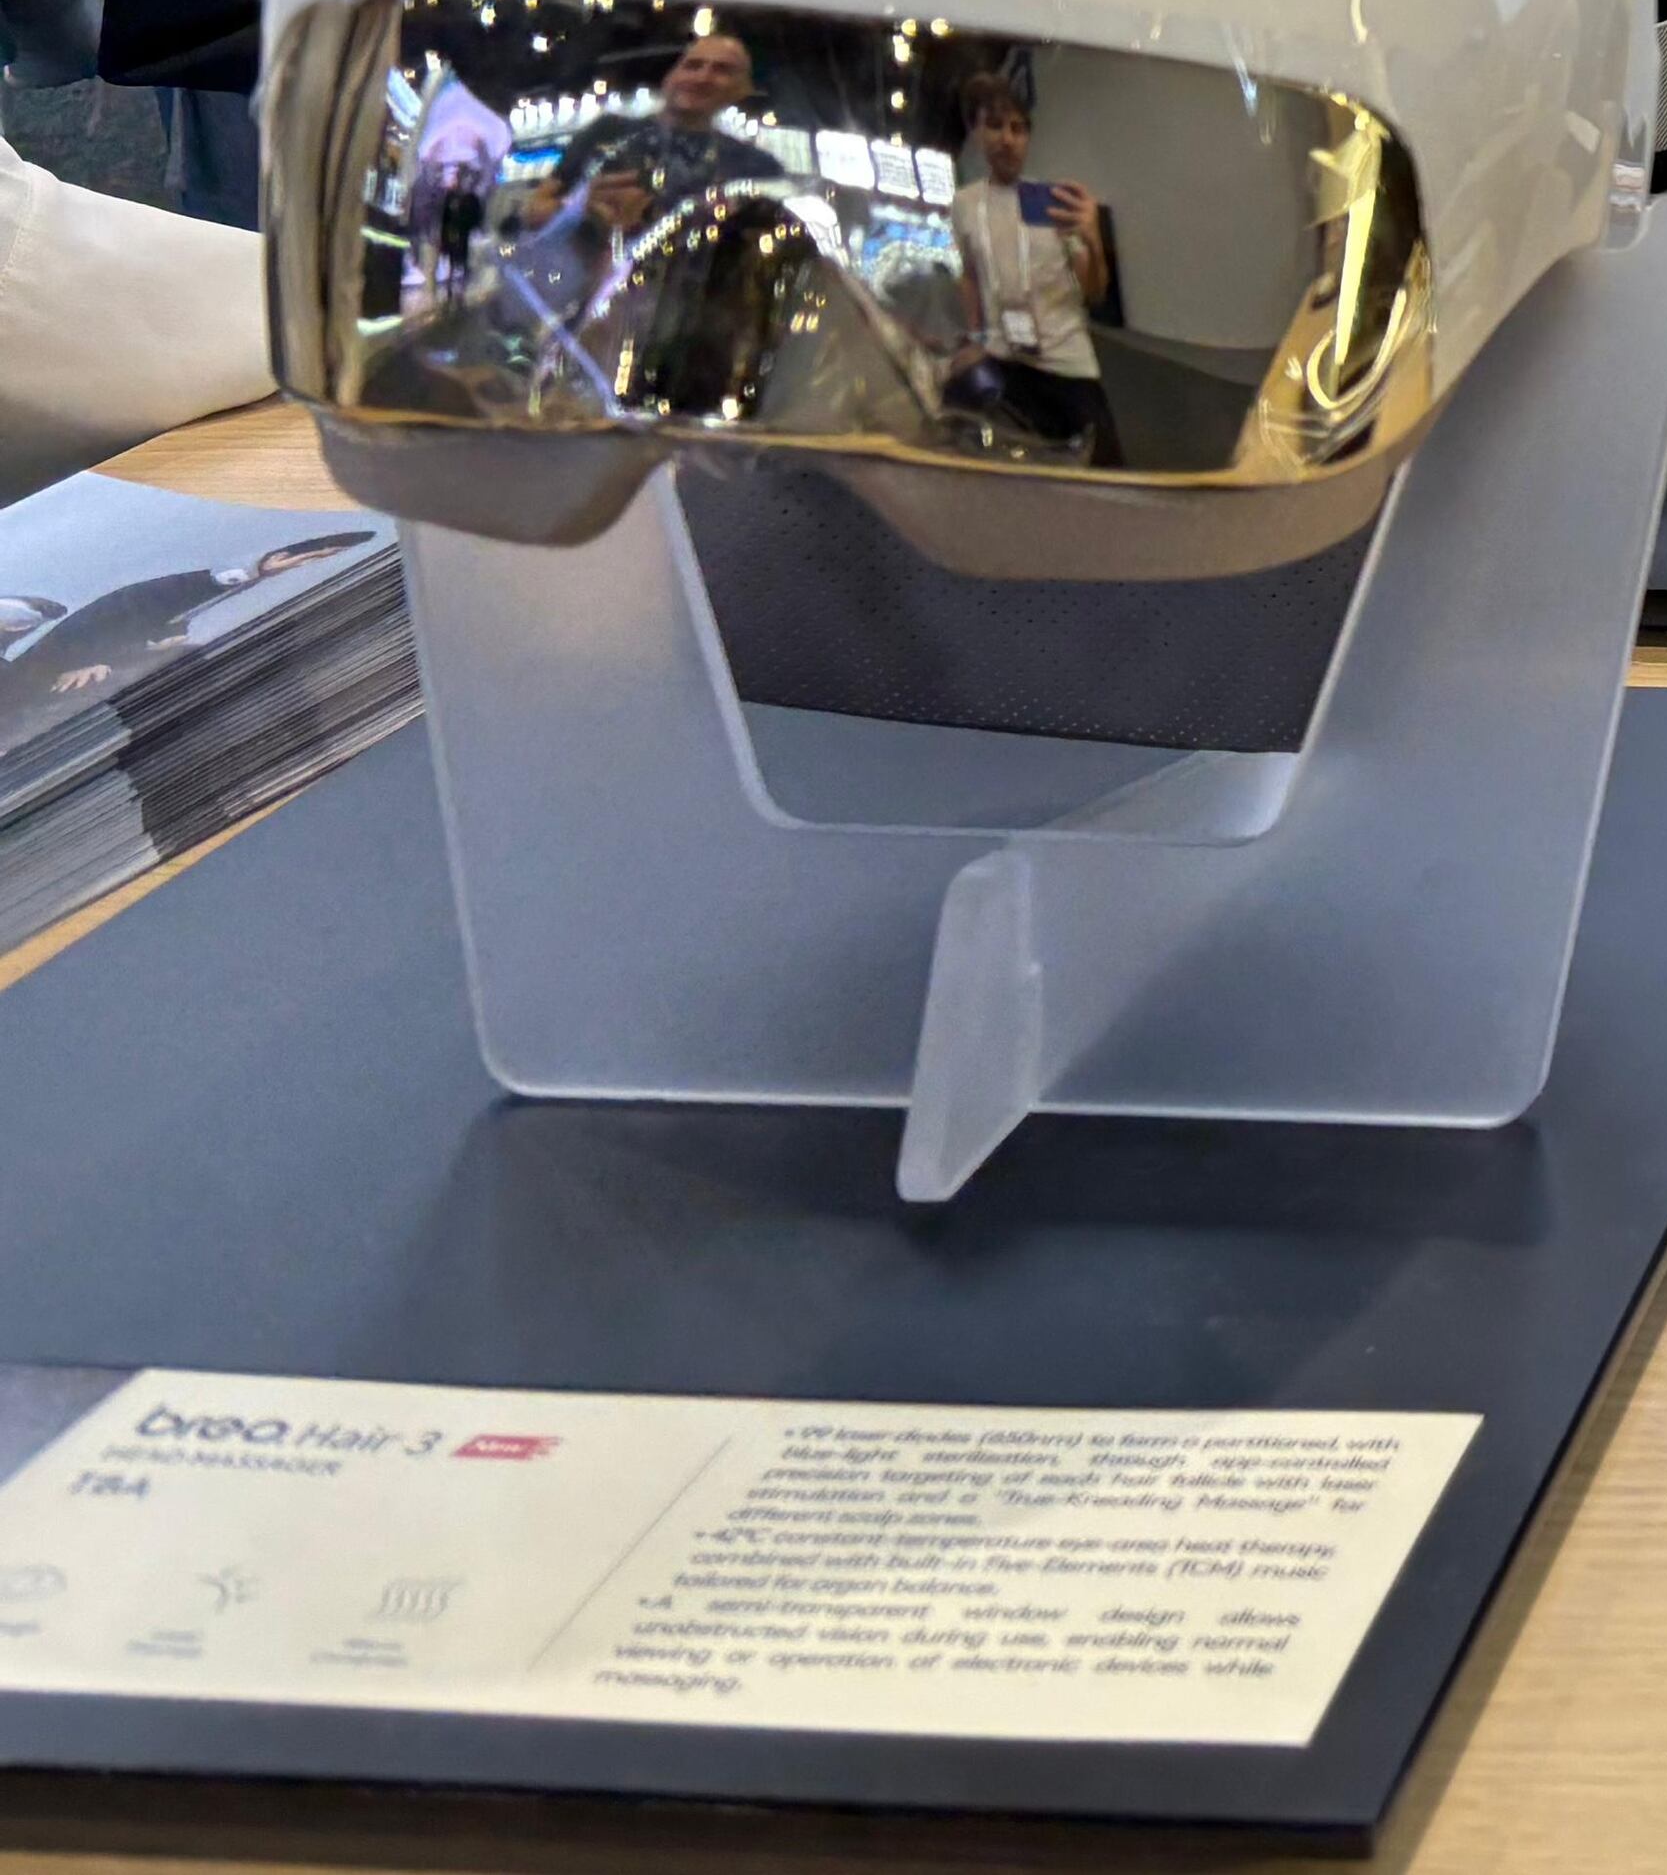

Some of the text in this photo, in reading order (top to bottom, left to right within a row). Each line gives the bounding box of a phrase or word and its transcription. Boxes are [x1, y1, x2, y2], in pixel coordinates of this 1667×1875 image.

[296, 1423, 399, 1451] Hair
[404, 1431, 445, 1456] 3
[896, 1489, 951, 1505] and
[1099, 1606, 1185, 1629] design
